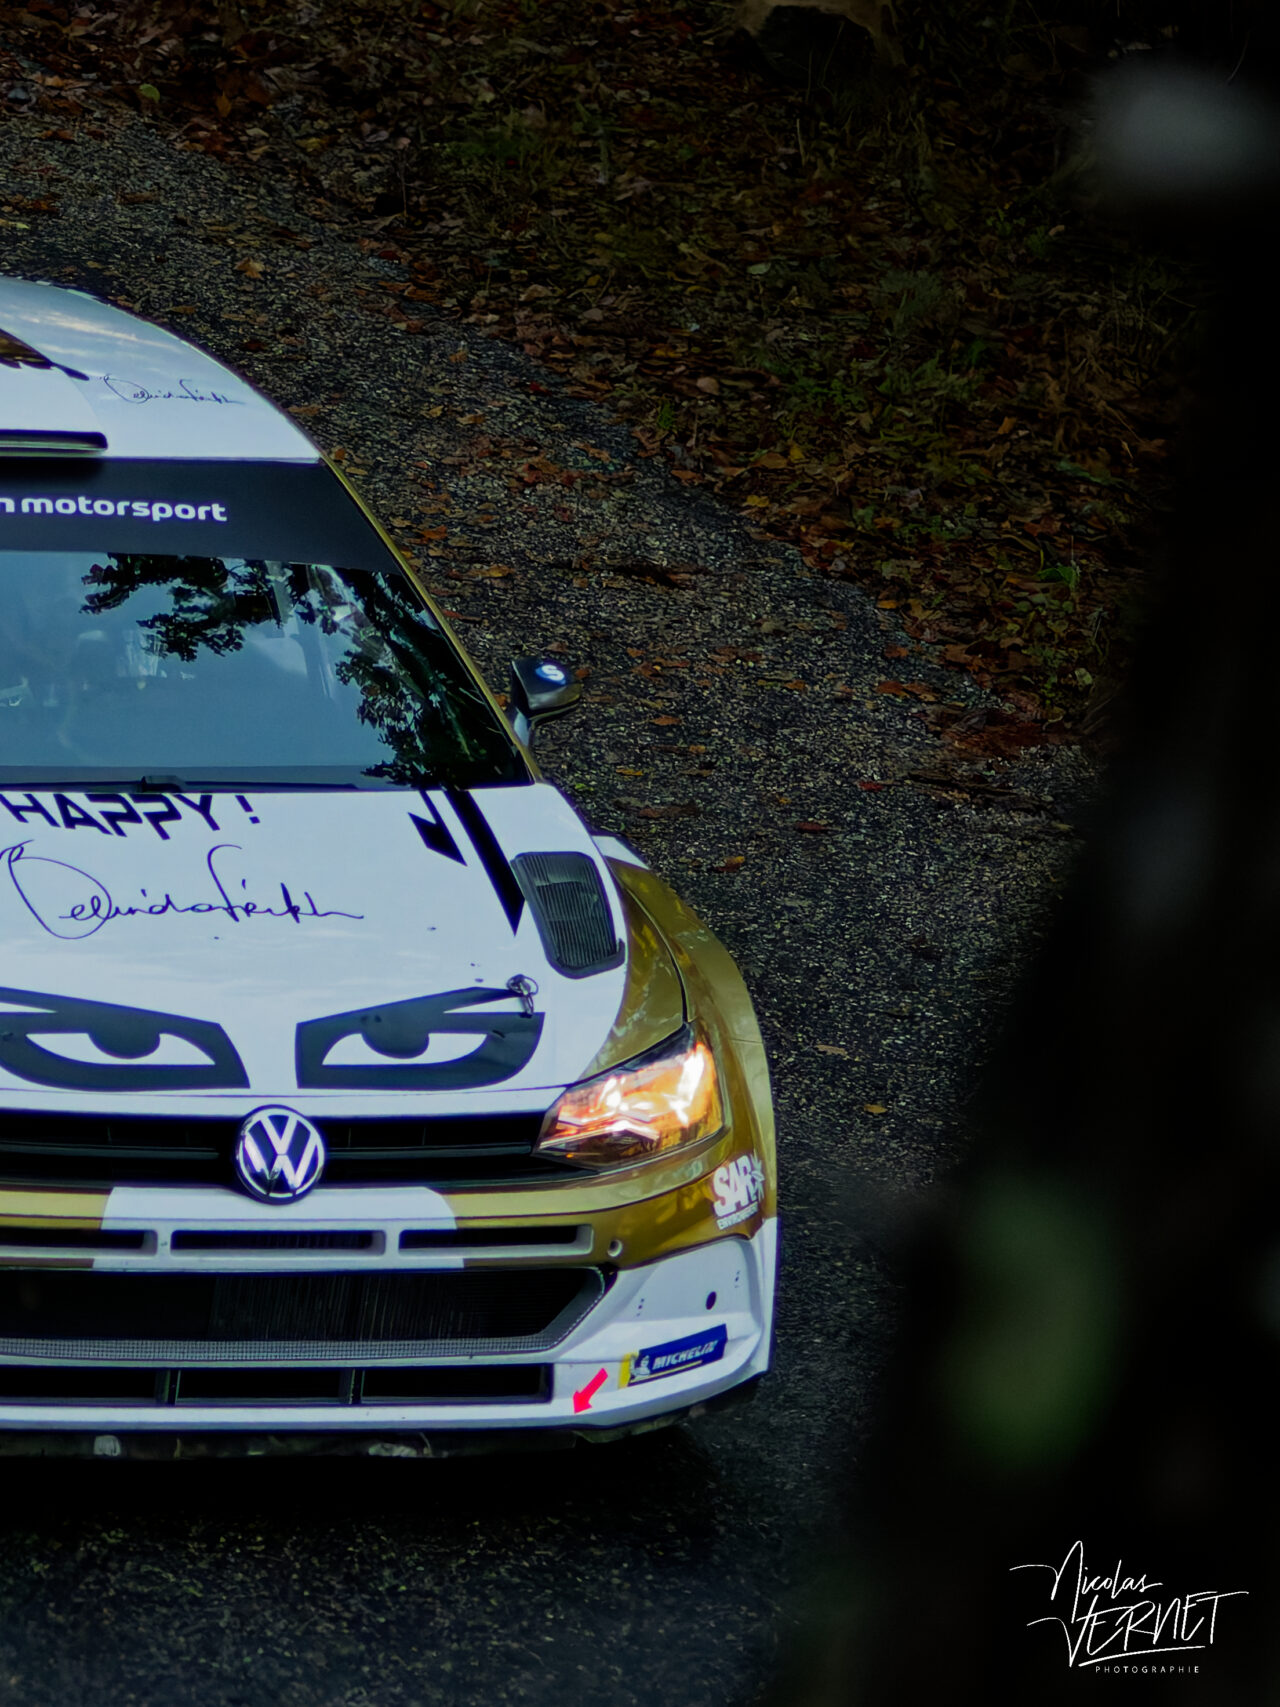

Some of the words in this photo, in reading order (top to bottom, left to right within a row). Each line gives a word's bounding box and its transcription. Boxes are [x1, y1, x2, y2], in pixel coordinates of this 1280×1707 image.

[21, 497, 228, 522] motorsport
[713, 1155, 758, 1217] SAR
[650, 1340, 719, 1373] MICHELIN
